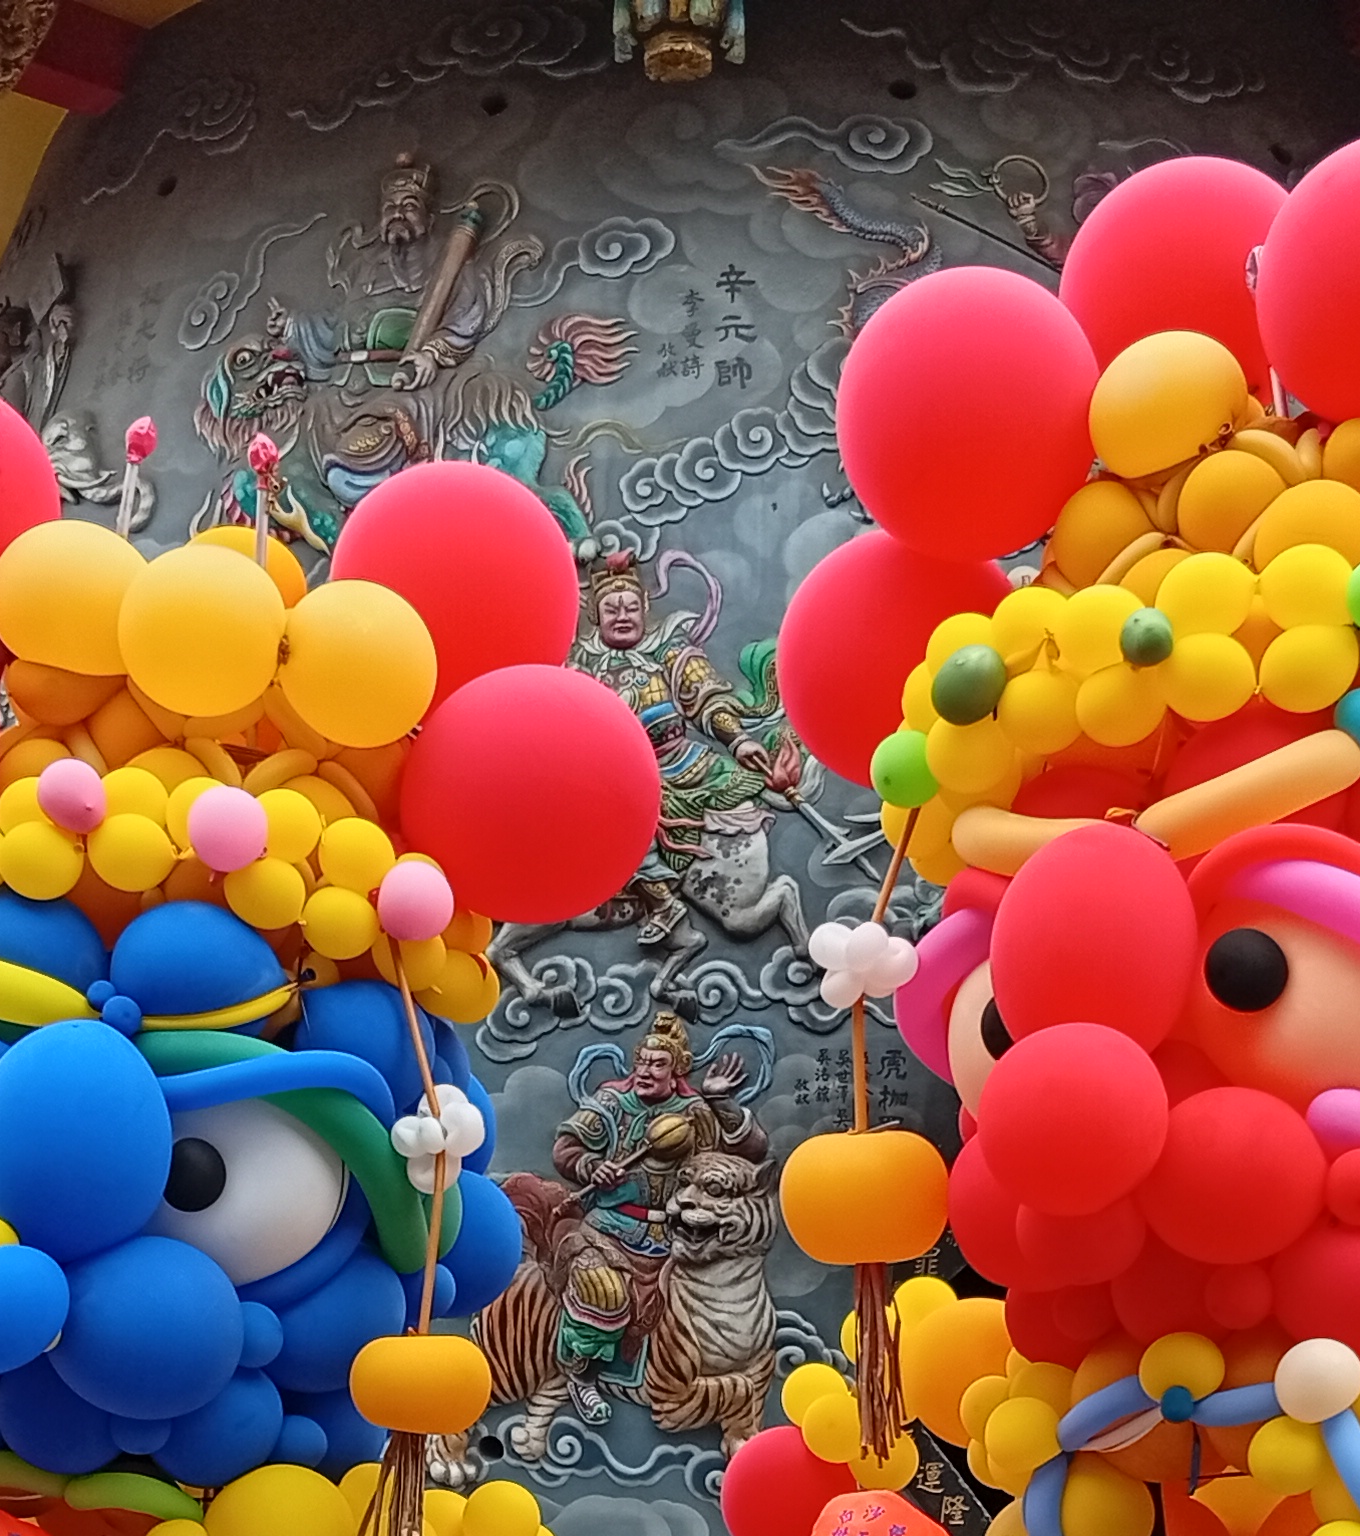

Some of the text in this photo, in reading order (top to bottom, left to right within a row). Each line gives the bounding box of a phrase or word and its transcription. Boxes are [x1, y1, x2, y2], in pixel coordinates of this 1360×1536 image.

[715, 263, 758, 389] 辛元帥
[877, 1050, 909, 1126] 虎枷
